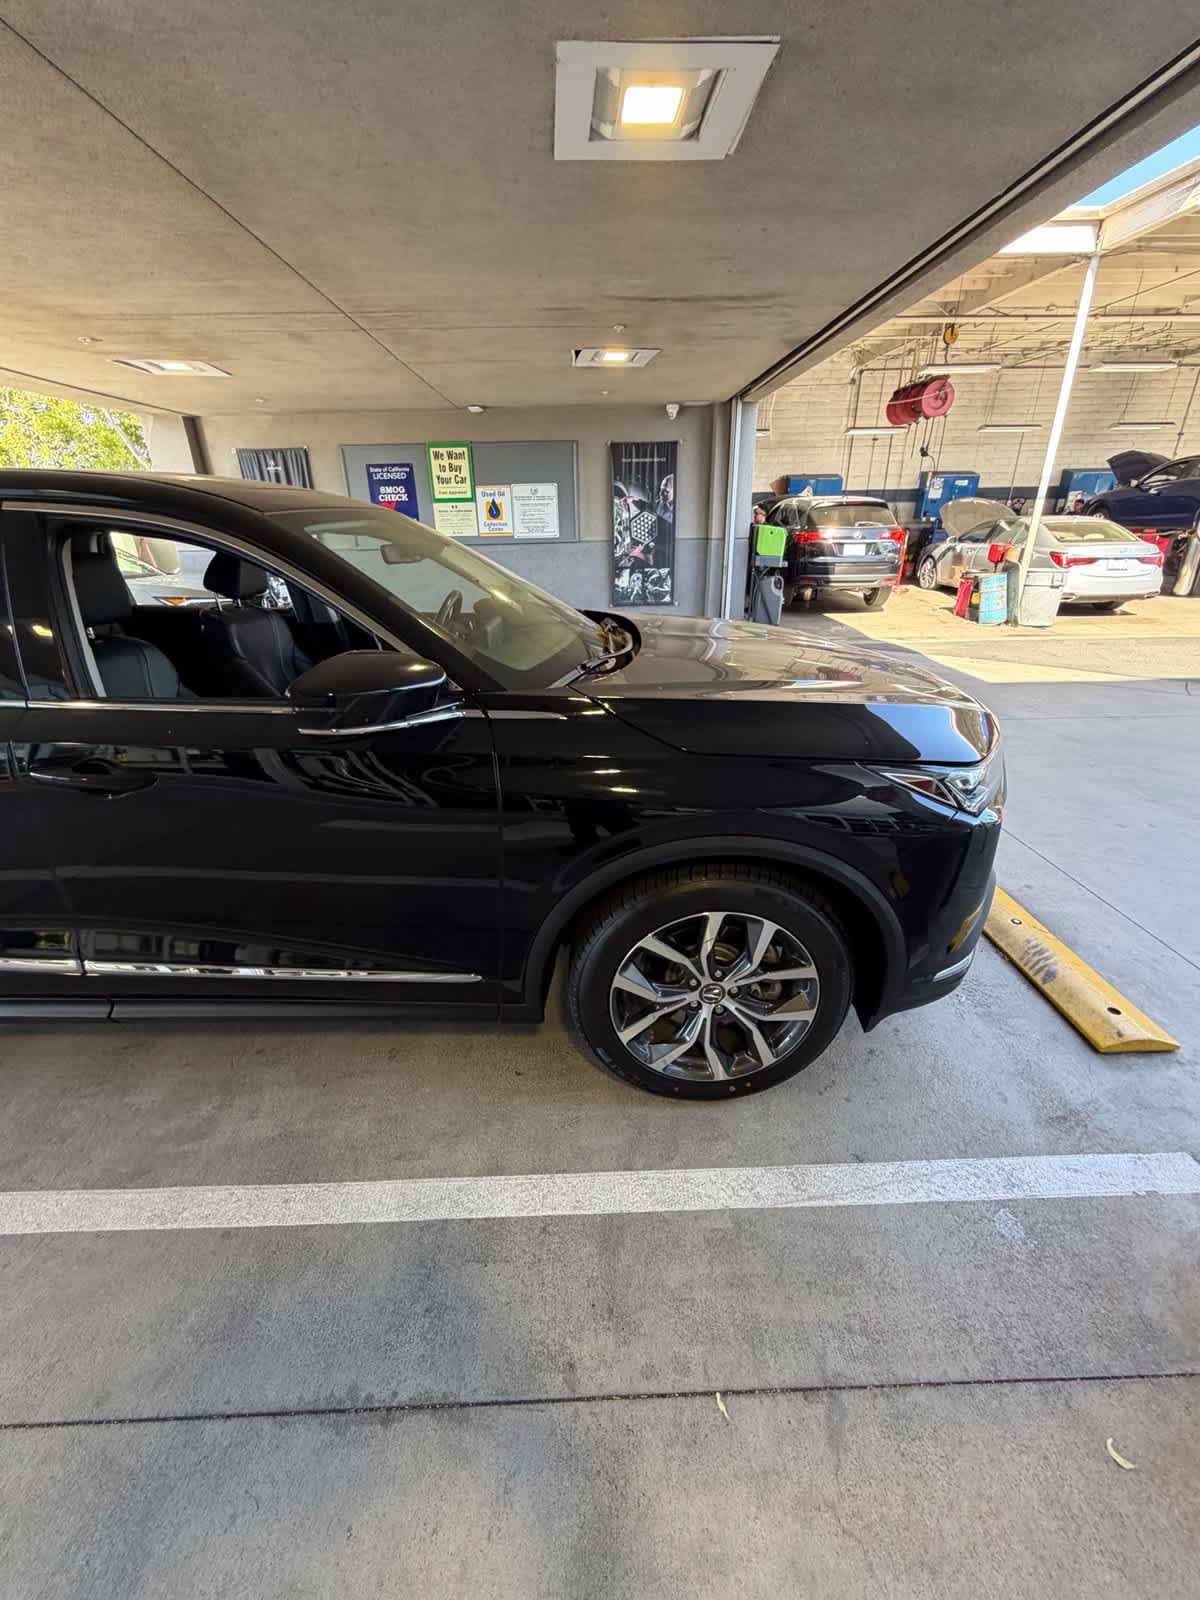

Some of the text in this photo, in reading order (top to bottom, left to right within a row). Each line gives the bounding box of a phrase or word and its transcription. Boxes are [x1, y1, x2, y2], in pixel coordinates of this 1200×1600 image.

[432, 450, 466, 461] We Want
[438, 462, 463, 475] to Buy
[372, 472, 407, 480] LICENSED
[435, 474, 467, 485] Your Car
[379, 486, 406, 494] SMOG
[378, 494, 409, 502] CHECK
